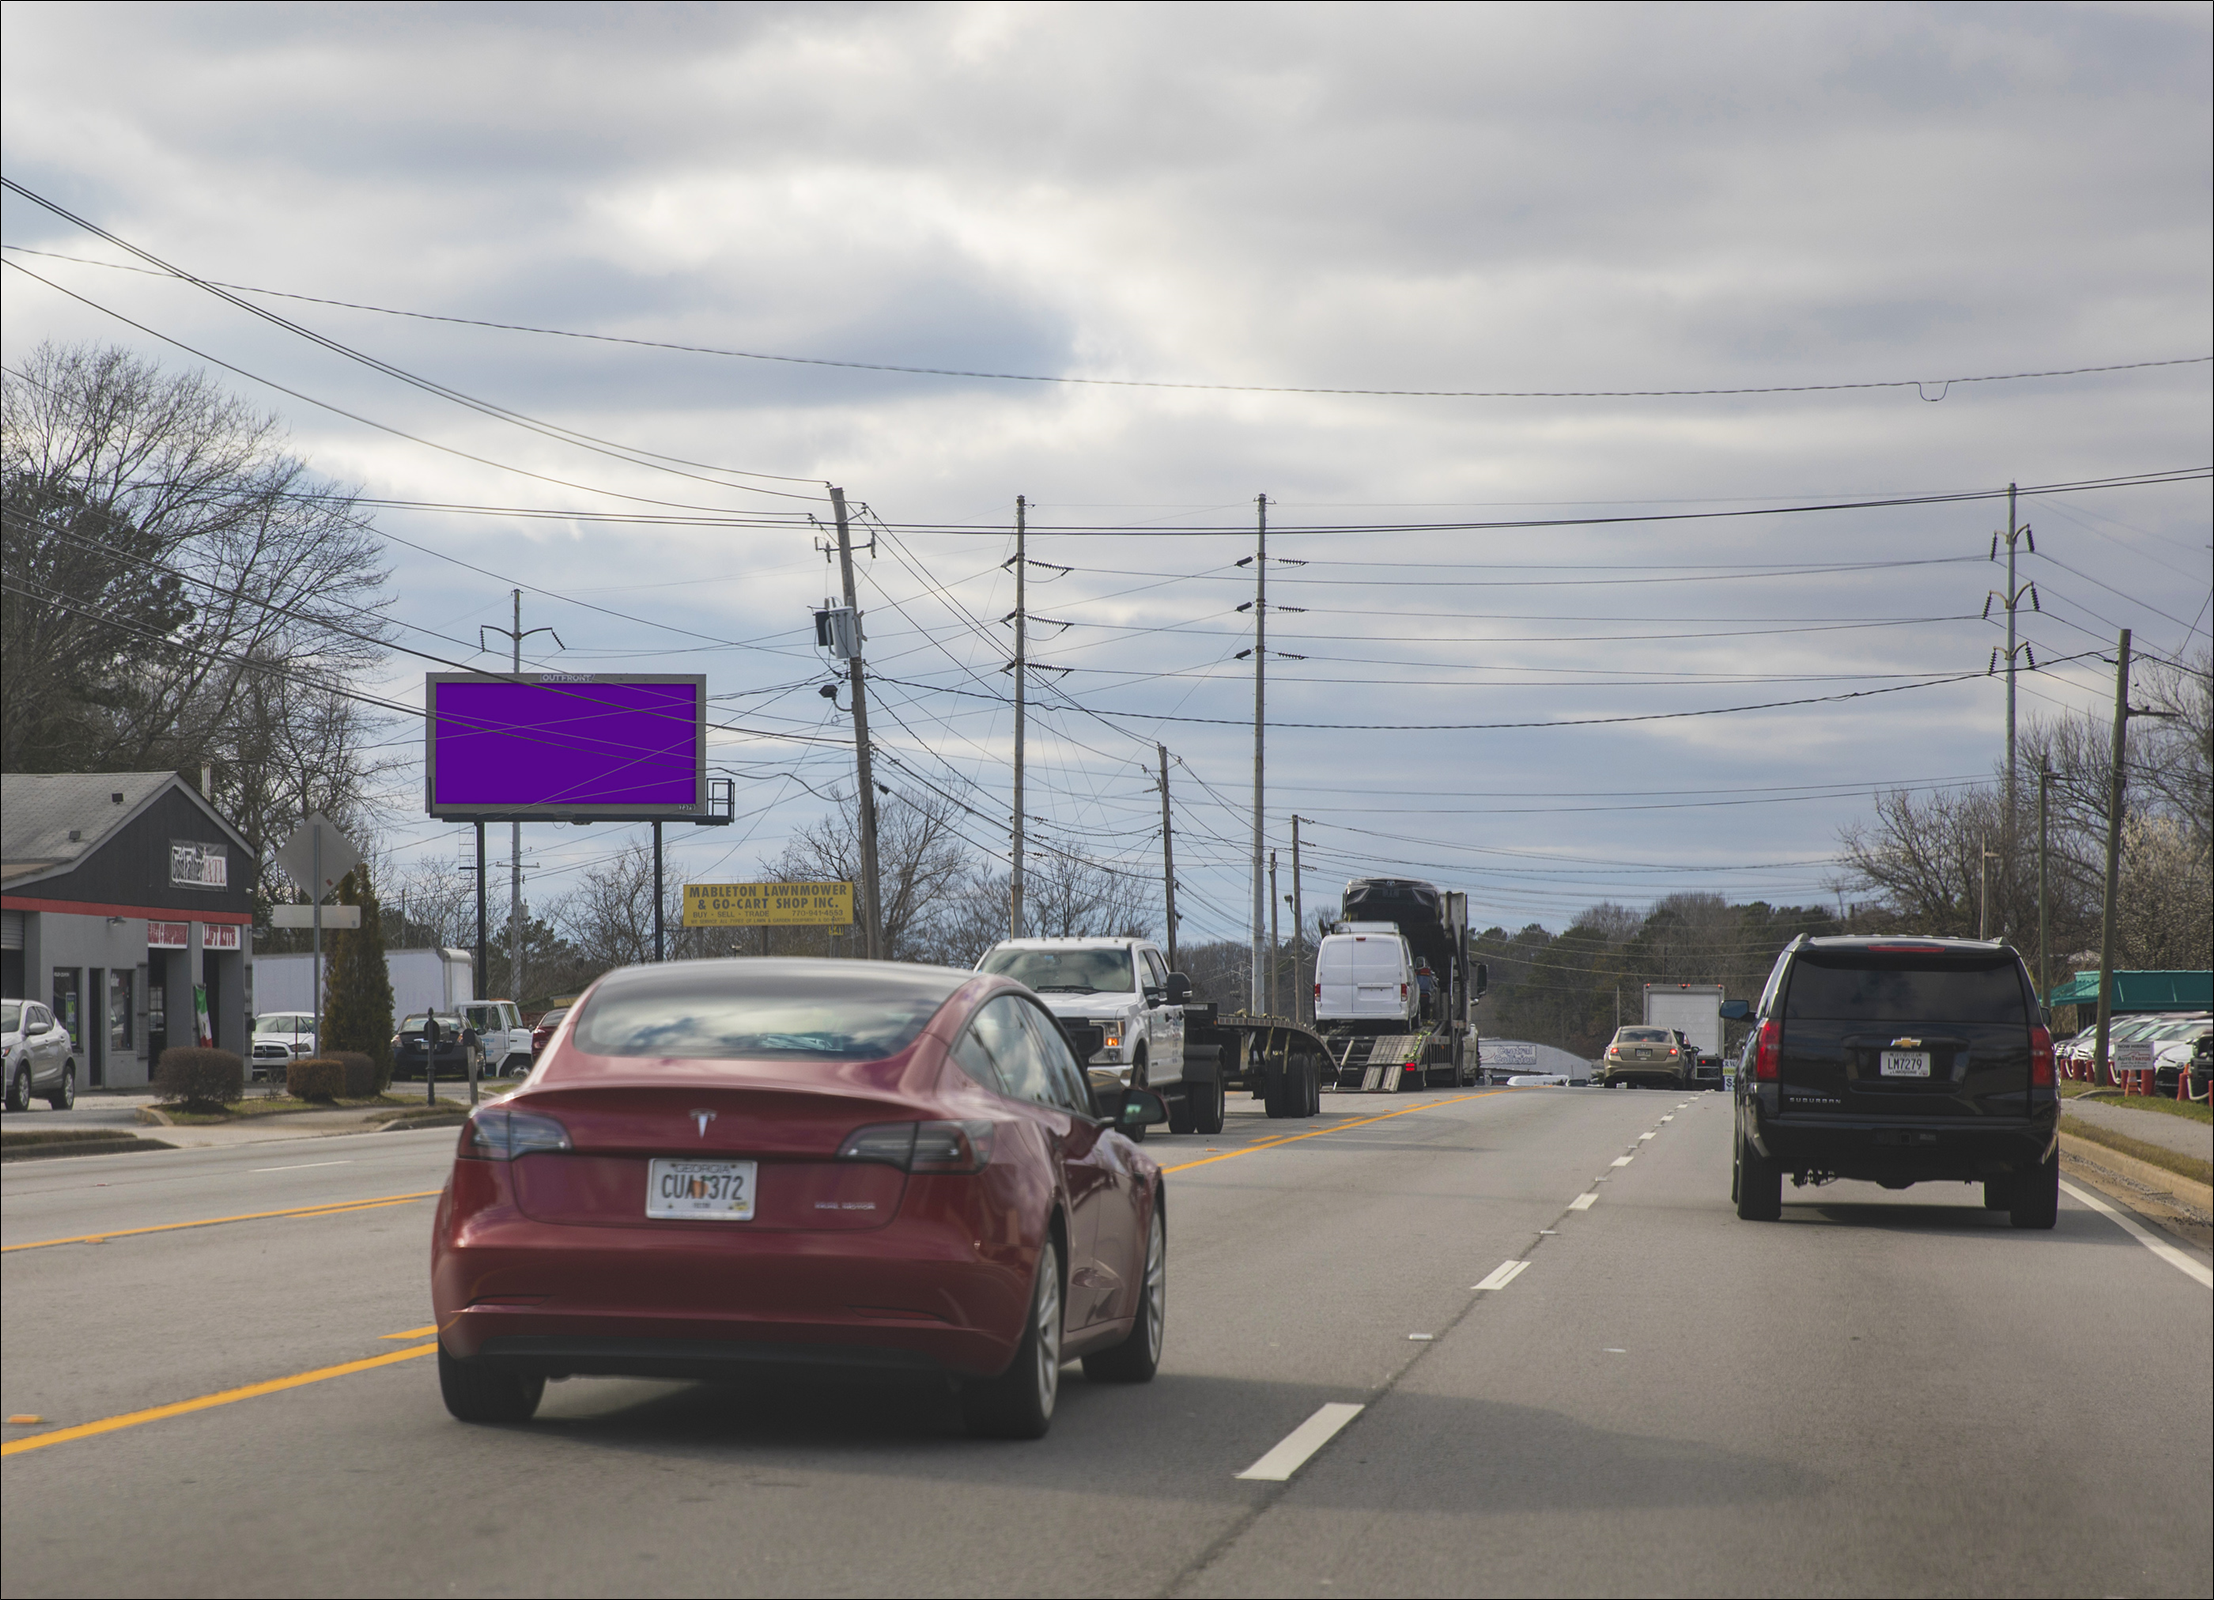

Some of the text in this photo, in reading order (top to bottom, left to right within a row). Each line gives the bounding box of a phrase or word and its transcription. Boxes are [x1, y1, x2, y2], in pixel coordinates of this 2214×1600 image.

[689, 884, 847, 898] MABLETON LAWNMOWER
[697, 897, 839, 910] & GO-CART SHOP INC.
[1497, 1045, 1533, 1055] Central
[1887, 1058, 1922, 1070] LM7279
[674, 1163, 730, 1173] GEORGIA
[661, 1174, 744, 1200] CUA1372
